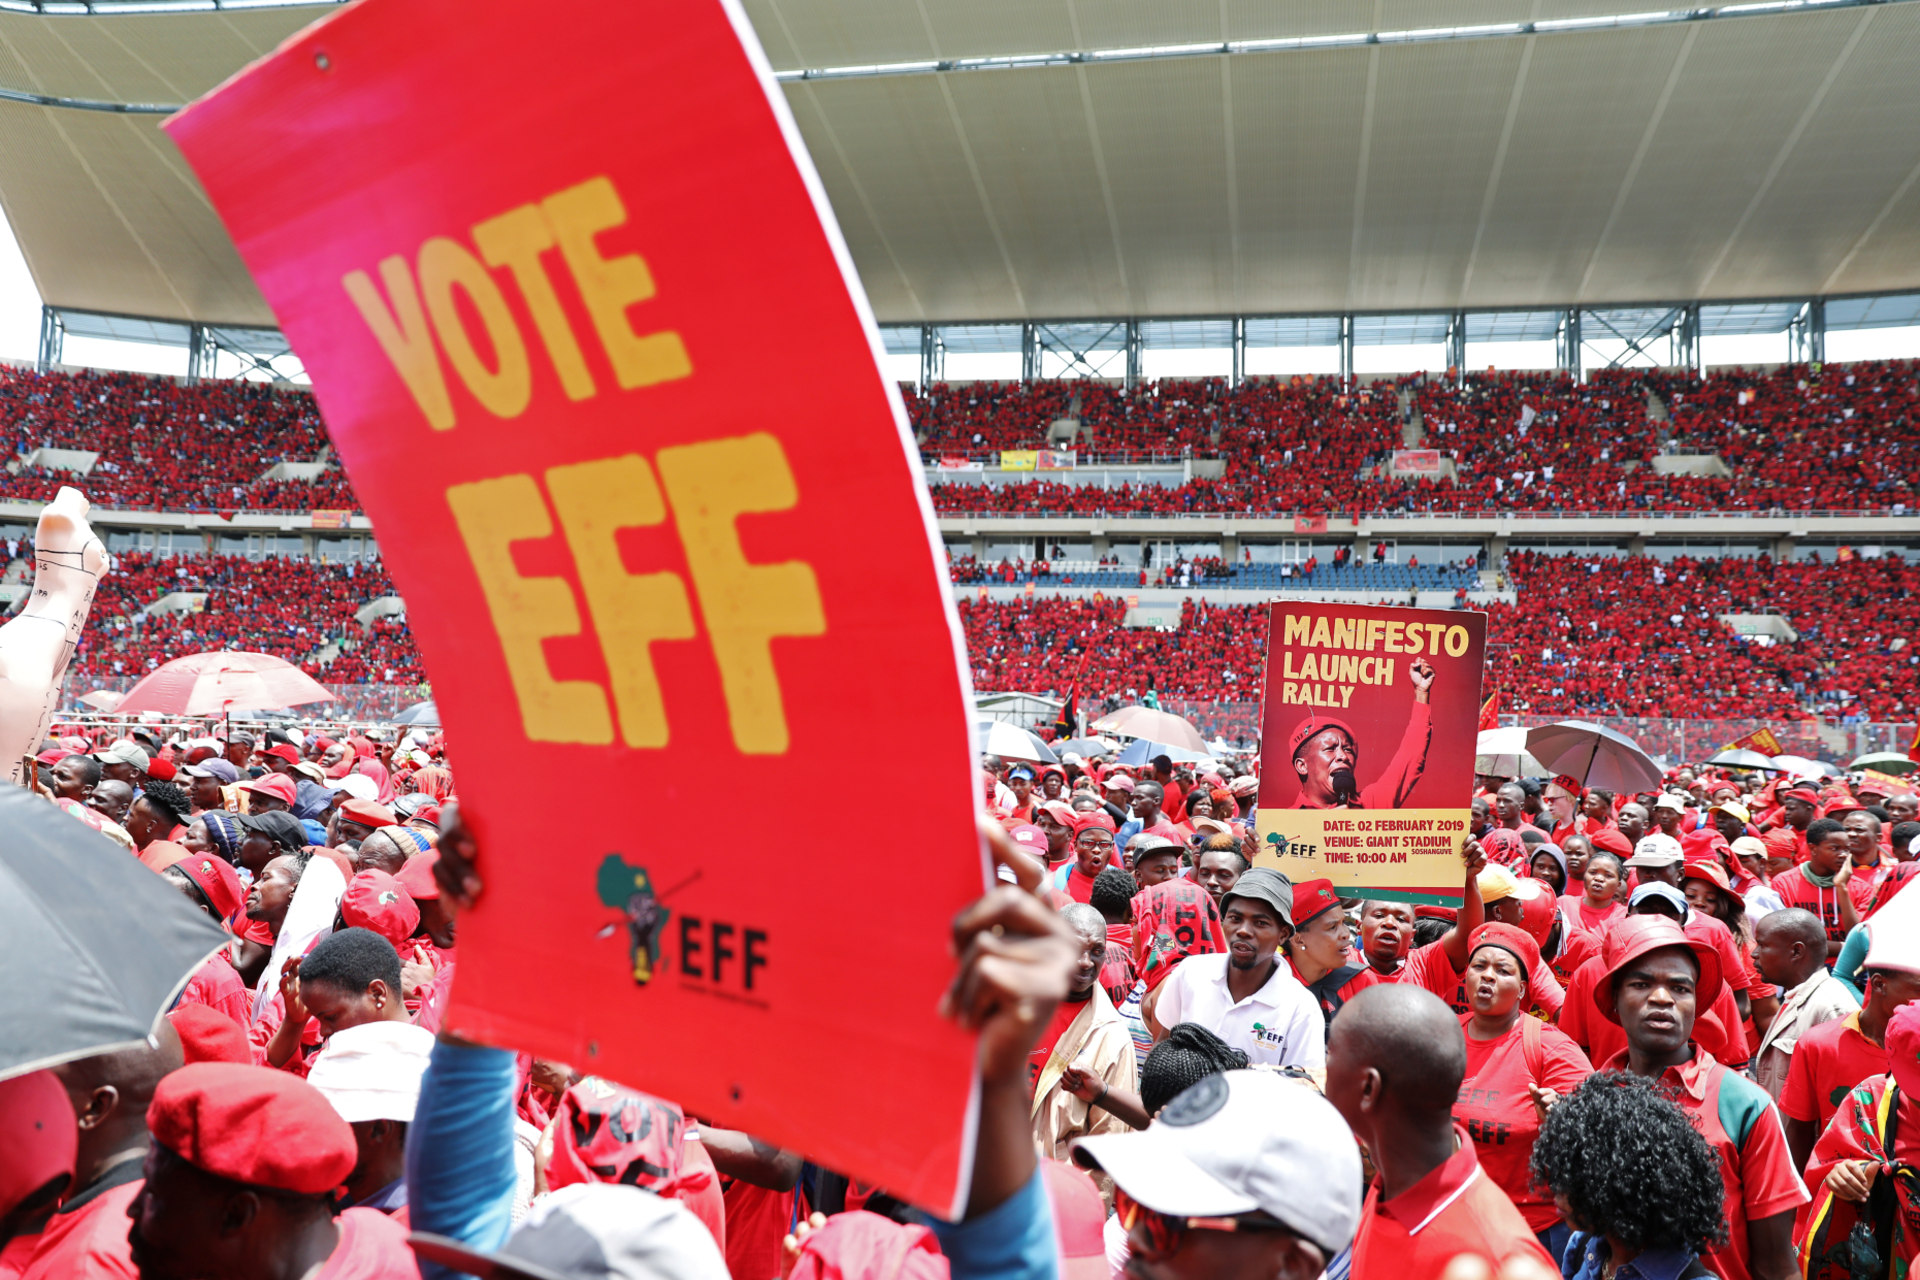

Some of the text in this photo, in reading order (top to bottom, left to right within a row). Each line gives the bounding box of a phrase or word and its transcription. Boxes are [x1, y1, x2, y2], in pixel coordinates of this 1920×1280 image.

[342, 175, 693, 432] VOTE
[445, 431, 827, 755] EFF
[1283, 614, 1470, 657] MANIFESTO
[1283, 652, 1394, 686] LAUNCH
[1282, 682, 1355, 708] RALLY
[1323, 820, 1464, 831] DATE: 02 FEBRUARY 2019
[1291, 843, 1316, 856] EFF
[1324, 836, 1451, 848] VENUE: GIANT STADIUM
[1324, 852, 1407, 863] TIME: 10:00 AM
[679, 915, 767, 991] EFF
[1267, 1032, 1284, 1043] EFF
[1457, 1087, 1499, 1107] EFF
[1468, 1118, 1511, 1145] EFF
